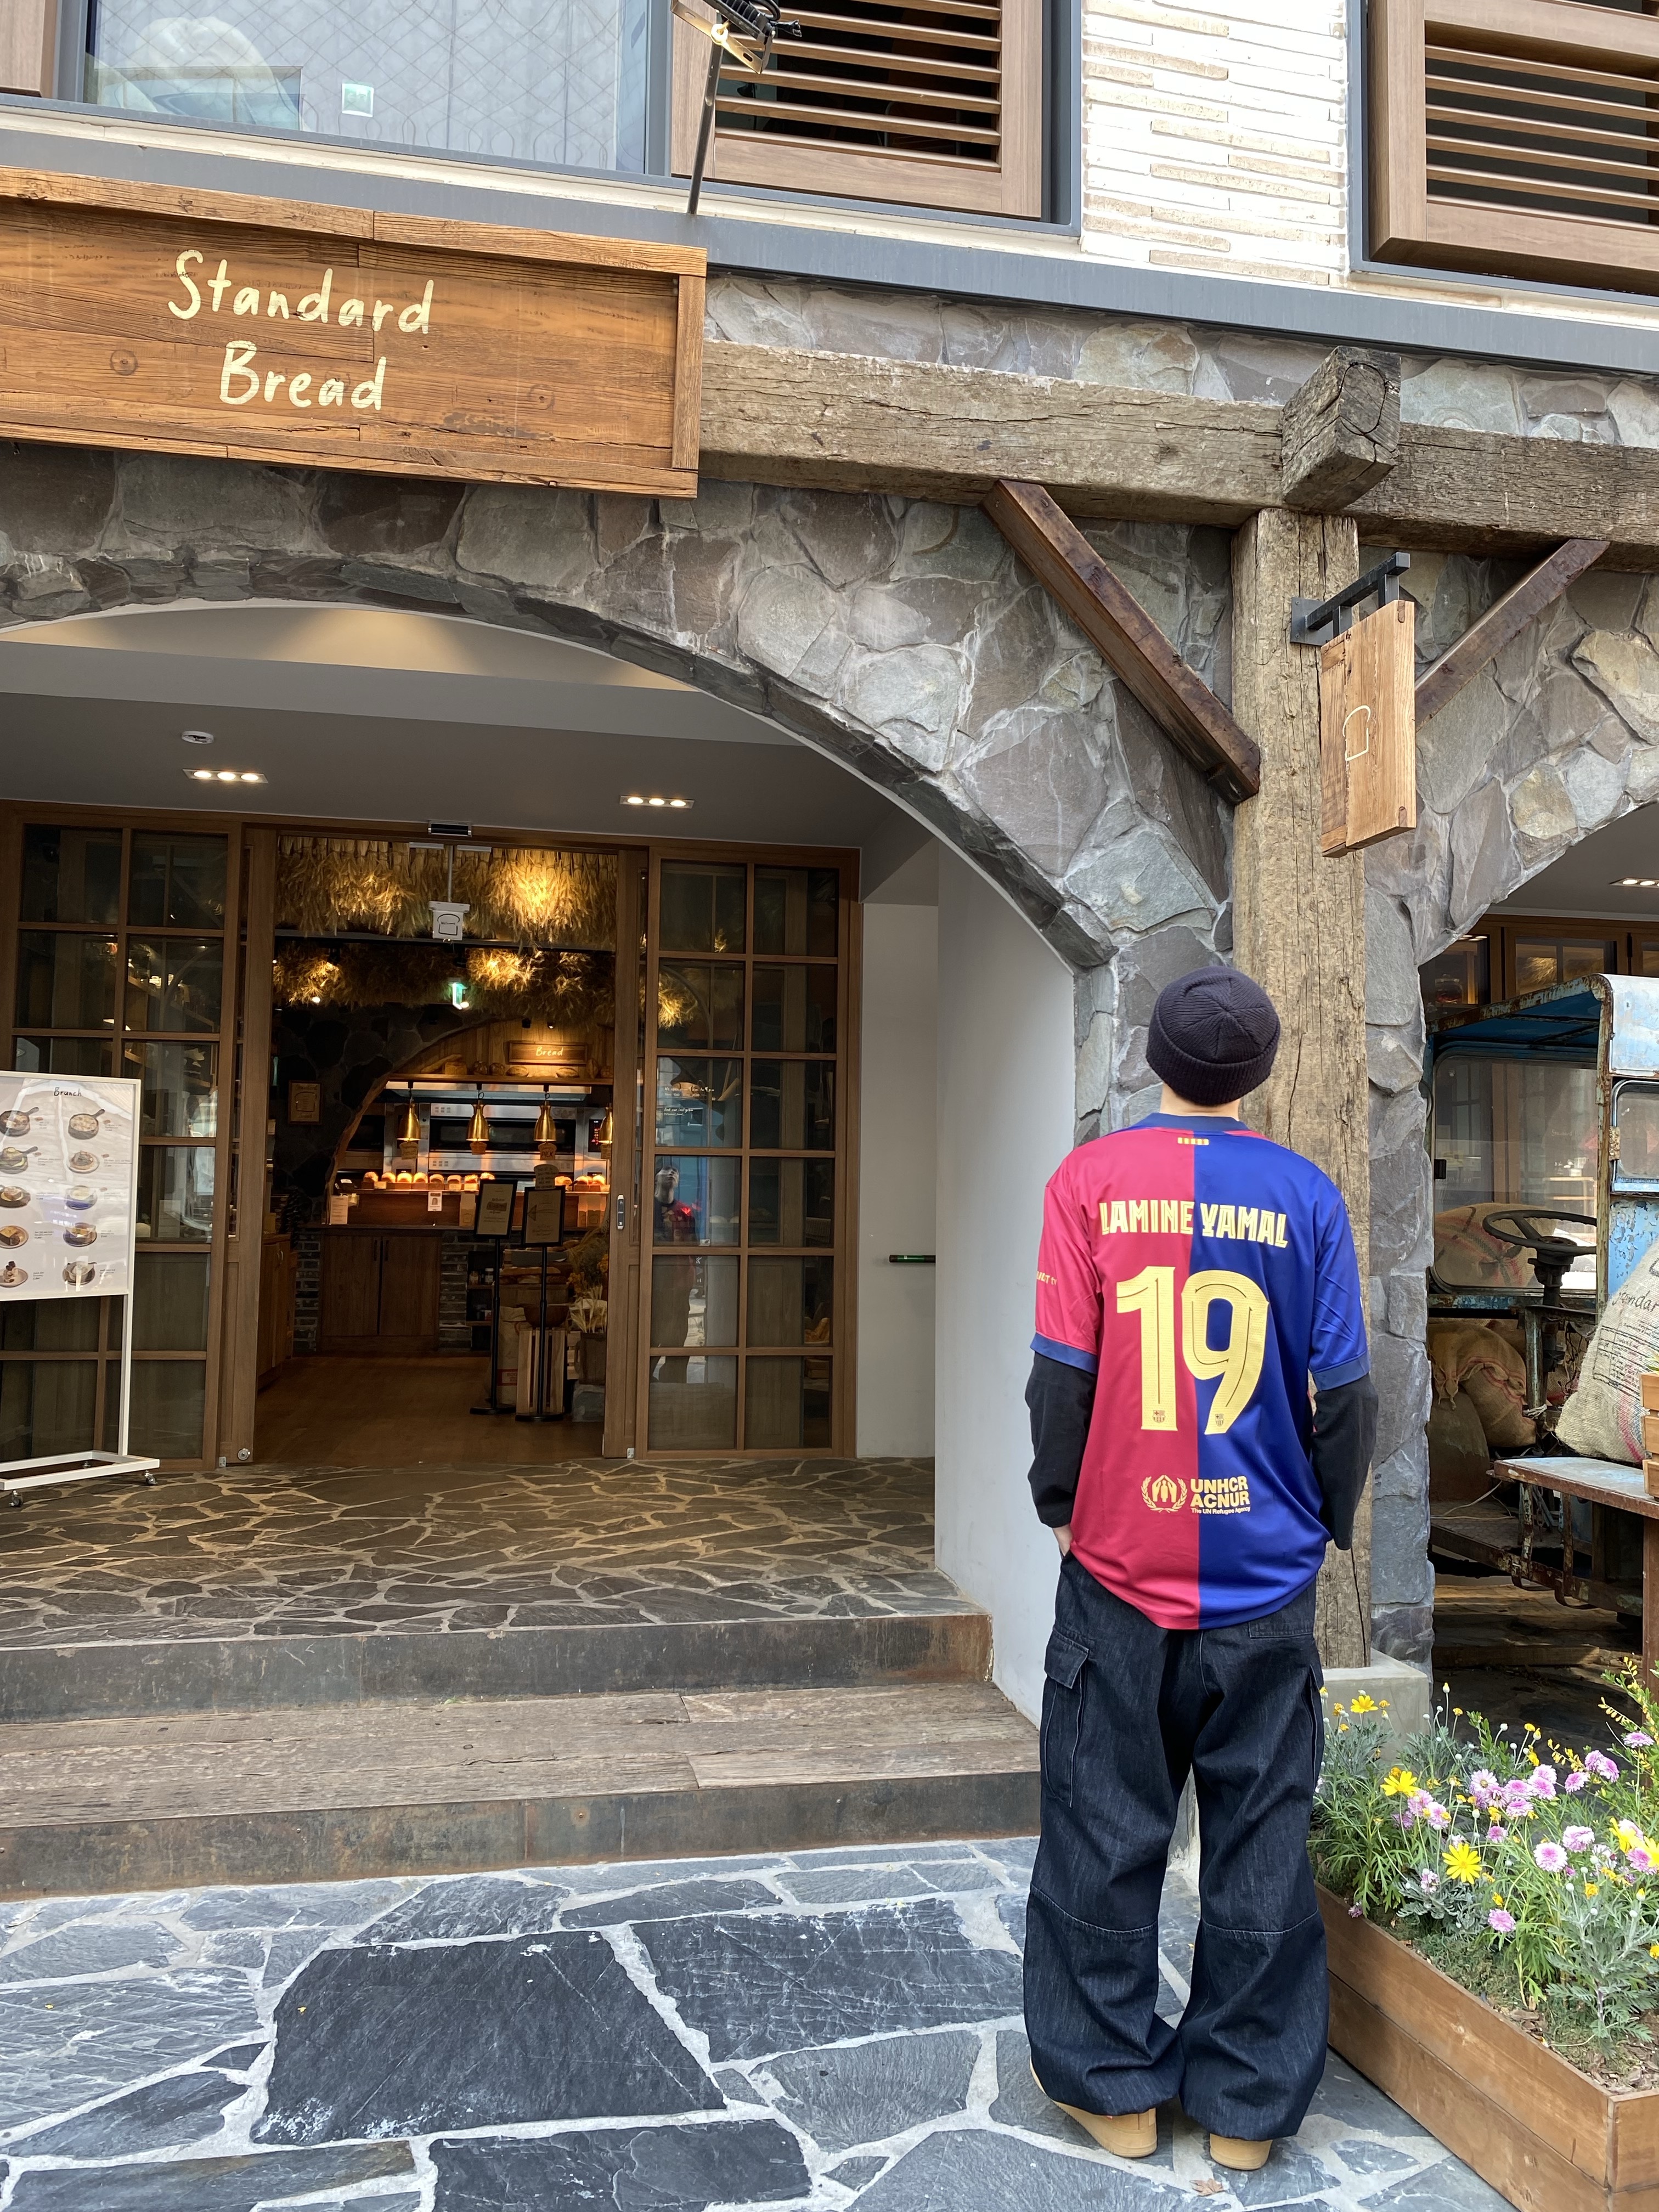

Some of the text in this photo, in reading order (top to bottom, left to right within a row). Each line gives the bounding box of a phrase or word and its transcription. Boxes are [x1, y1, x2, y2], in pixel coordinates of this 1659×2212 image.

[168, 249, 433, 334] Standard
[219, 340, 386, 410] Bread
[536, 1046, 563, 1056] Bread
[54, 1087, 82, 1097] Brunch
[1099, 1200, 1288, 1248] LAMINE YAMAL
[1116, 1266, 1269, 1435] 19
[1190, 1476, 1248, 1493] UNHCR
[1190, 1491, 1250, 1508] ACNUR
